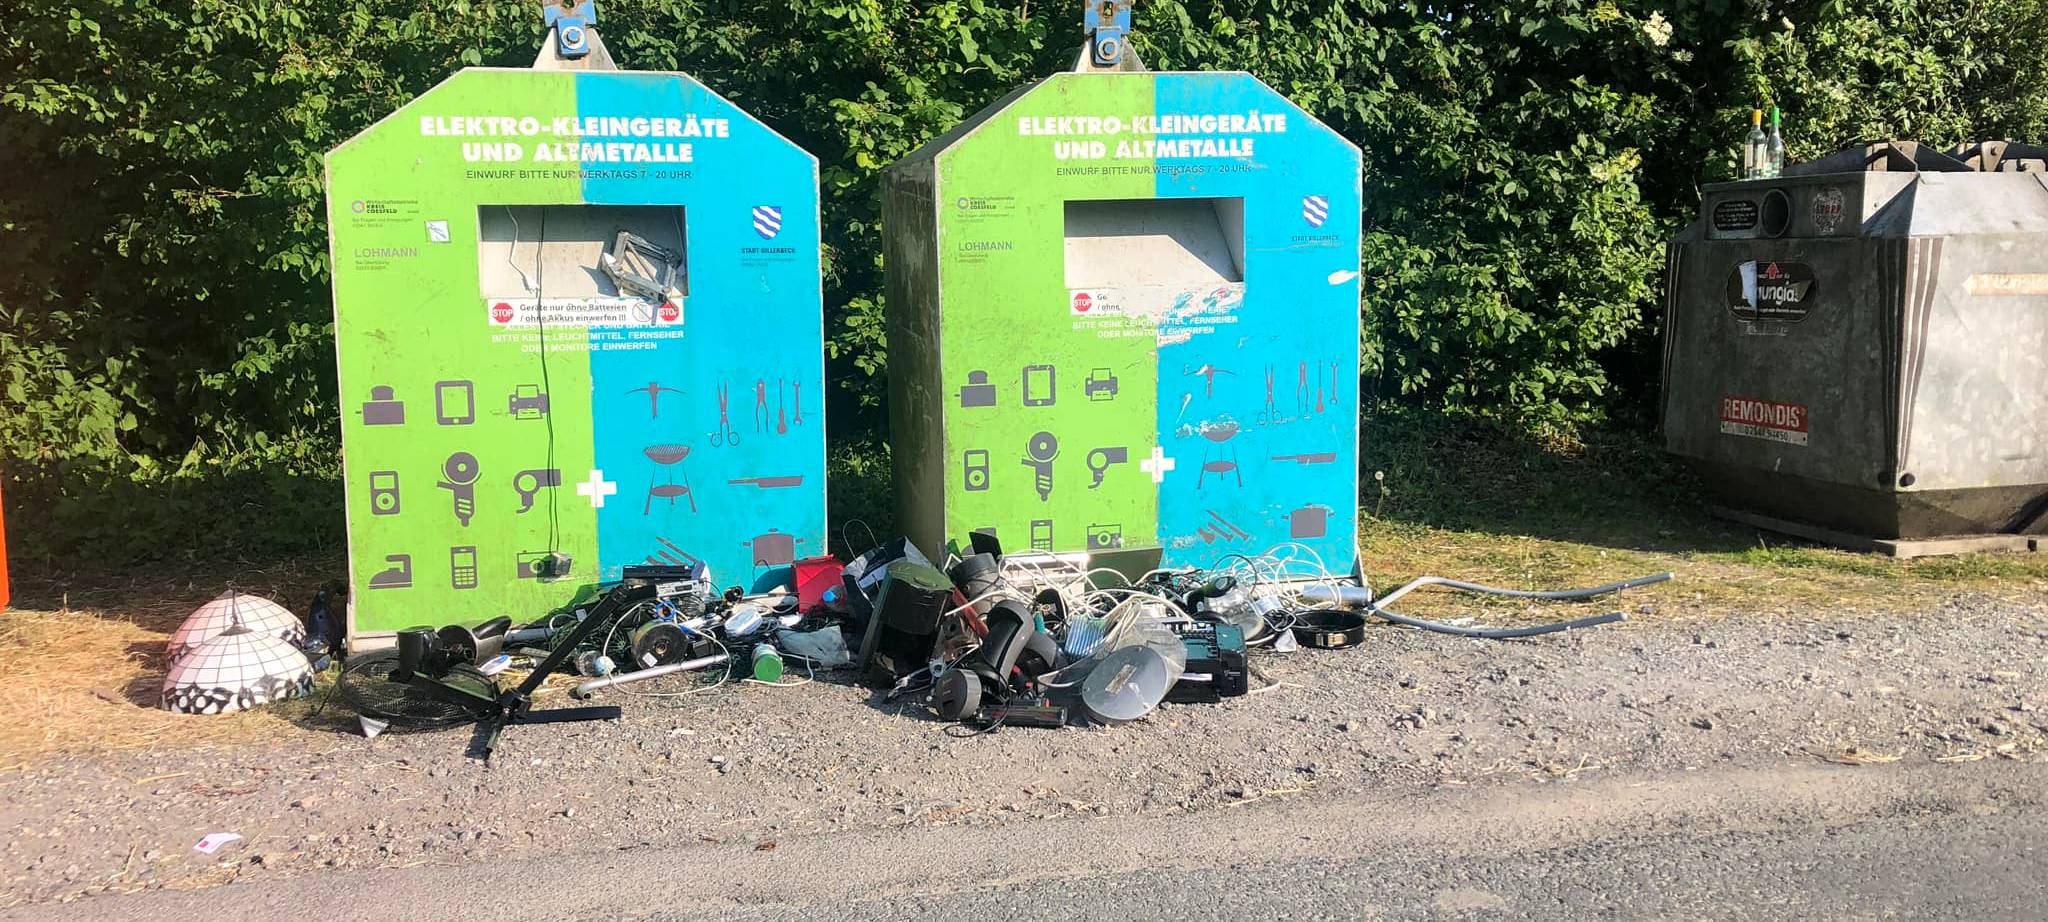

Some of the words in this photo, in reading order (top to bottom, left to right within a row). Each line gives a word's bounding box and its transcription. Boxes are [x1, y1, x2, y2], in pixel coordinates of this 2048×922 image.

[420, 113, 730, 137] ELEKTRO-KLEINGERÄTE
[1018, 109, 1287, 136] ELEKTRO-KLEINGERÄTE
[462, 142, 524, 162] UND
[533, 142, 694, 163] ALTMETALLE
[1054, 140, 1107, 160] UND
[1115, 138, 1254, 159] ALTMETALLE
[466, 170, 517, 179] EINWURF
[519, 170, 550, 179] BITTE
[552, 170, 576, 179] NUR
[578, 170, 638, 179] WERKTAGS
[641, 170, 647, 178] 7
[655, 170, 667, 179] 20
[669, 170, 693, 179] UHR
[1056, 167, 1099, 176] EINWURF
[1101, 166, 1129, 175] BITTE
[1131, 166, 1151, 174] NUR
[1152, 164, 1205, 174] WERKTAGS
[1219, 164, 1231, 173] 20
[1232, 163, 1252, 172] UHR
[958, 241, 1013, 252] LOHMANN
[354, 247, 418, 258] LOHMANN
[566, 303, 587, 311] ohne
[588, 303, 627, 311] Batterien
[493, 308, 514, 318] STOP
[548, 313, 574, 322] Akkus
[575, 313, 617, 322] einwerfen
[1190, 315, 1238, 325] FERNSEHER
[492, 335, 519, 343] BITTE
[628, 330, 684, 340] FERNSEHER
[1097, 330, 1121, 339] ODER
[603, 341, 658, 351] EINWERFEN
[1723, 398, 1801, 428] REMONDIS
